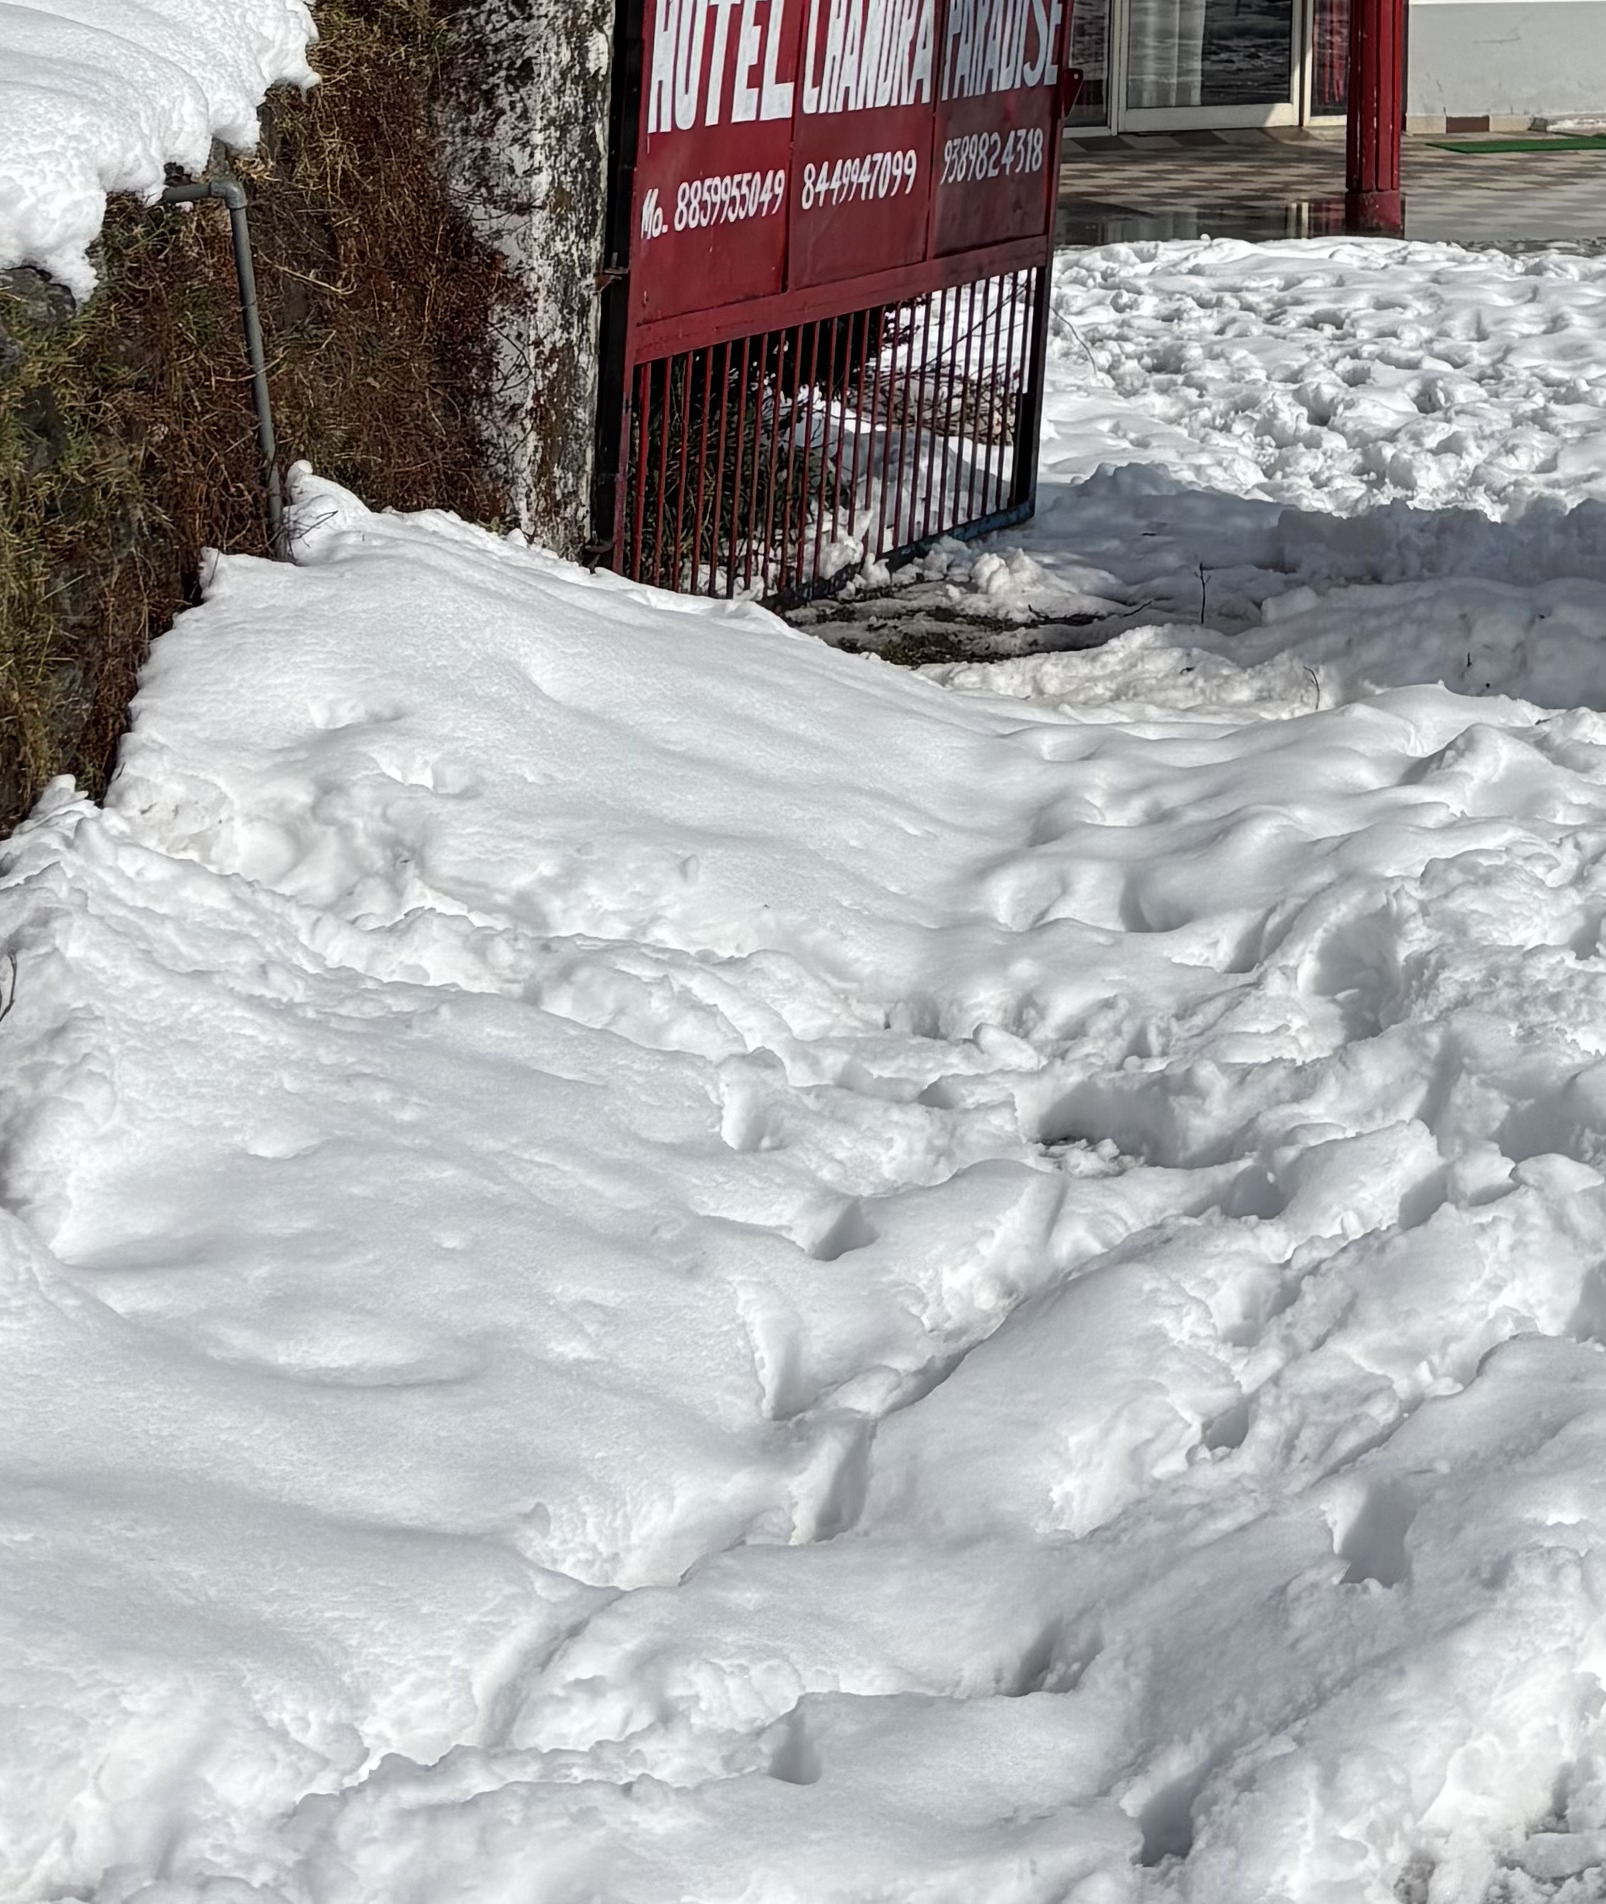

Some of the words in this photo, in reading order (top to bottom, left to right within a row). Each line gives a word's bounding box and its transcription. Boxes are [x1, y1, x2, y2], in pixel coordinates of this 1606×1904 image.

[640, 188, 669, 241] Mo.
[674, 169, 786, 233] 8859955049
[801, 149, 918, 210] 8449947099
